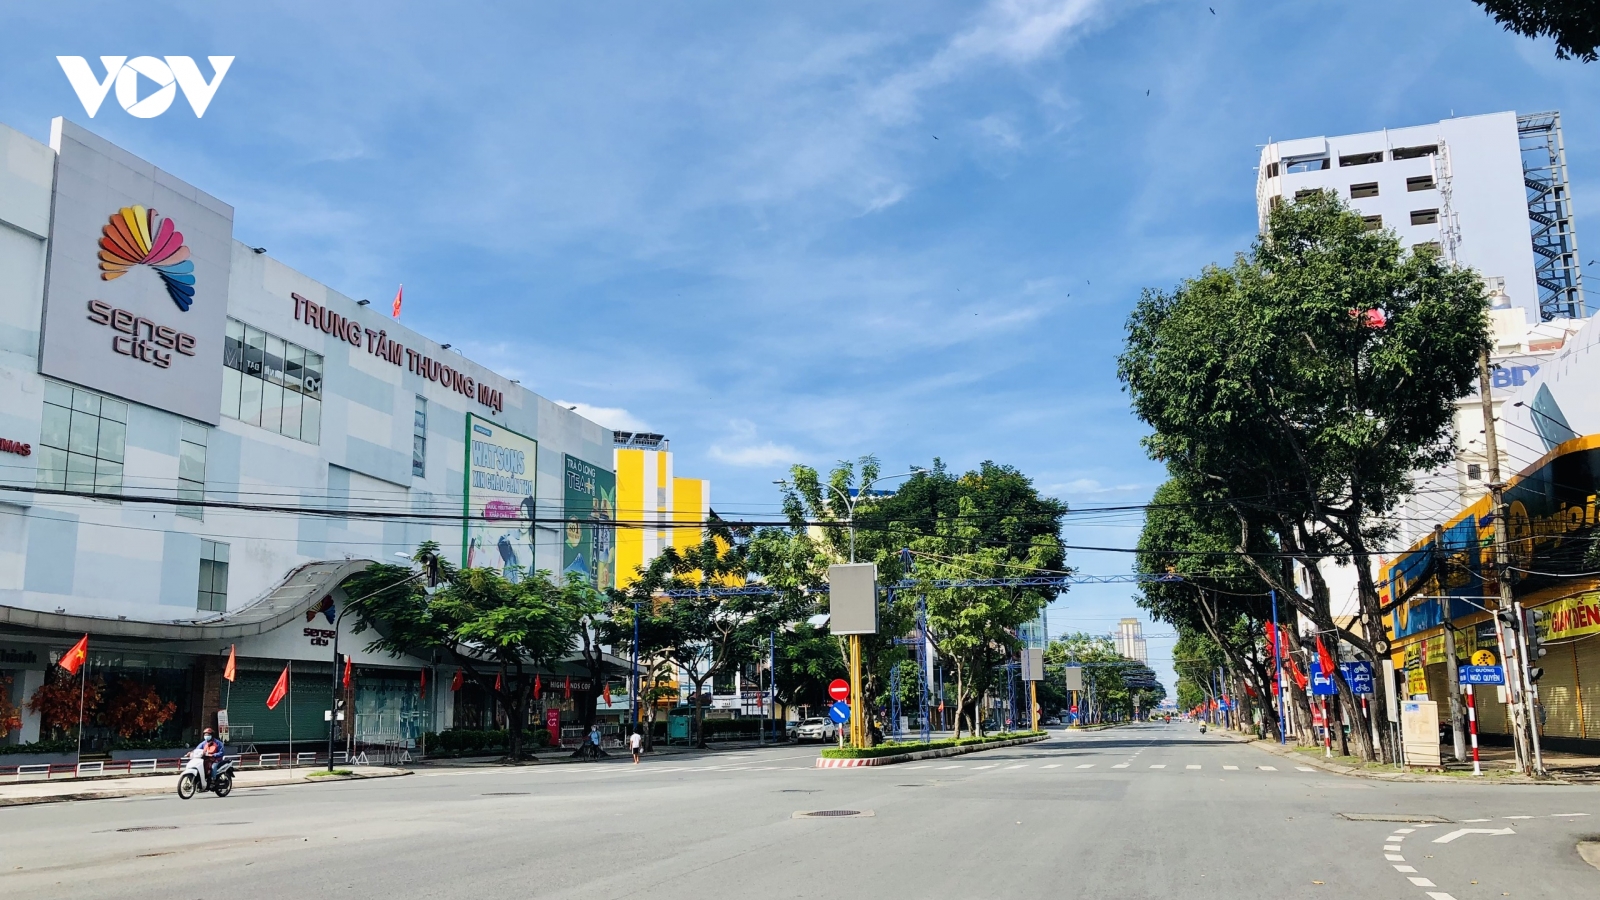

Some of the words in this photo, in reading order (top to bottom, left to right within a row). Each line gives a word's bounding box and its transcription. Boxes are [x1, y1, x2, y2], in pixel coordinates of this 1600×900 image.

[87, 300, 196, 357] sense
[113, 334, 173, 370] city
[291, 292, 362, 347] TRUNG
[365, 325, 403, 367] TÂM
[406, 349, 475, 398] THƯƠNG
[477, 380, 504, 415] MẠI
[472, 440, 525, 475] WATSONS
[583, 465, 596, 478] LONG
[472, 470, 485, 488] XIN
[486, 471, 505, 492] CHÀO
[506, 472, 520, 494] CẦN
[303, 627, 336, 639] sense
[310, 637, 329, 646] city
[550, 681, 581, 690] HIGHLNDS
[1469, 673, 1482, 682] NGÔ
[1482, 672, 1501, 682] QUYỀN
